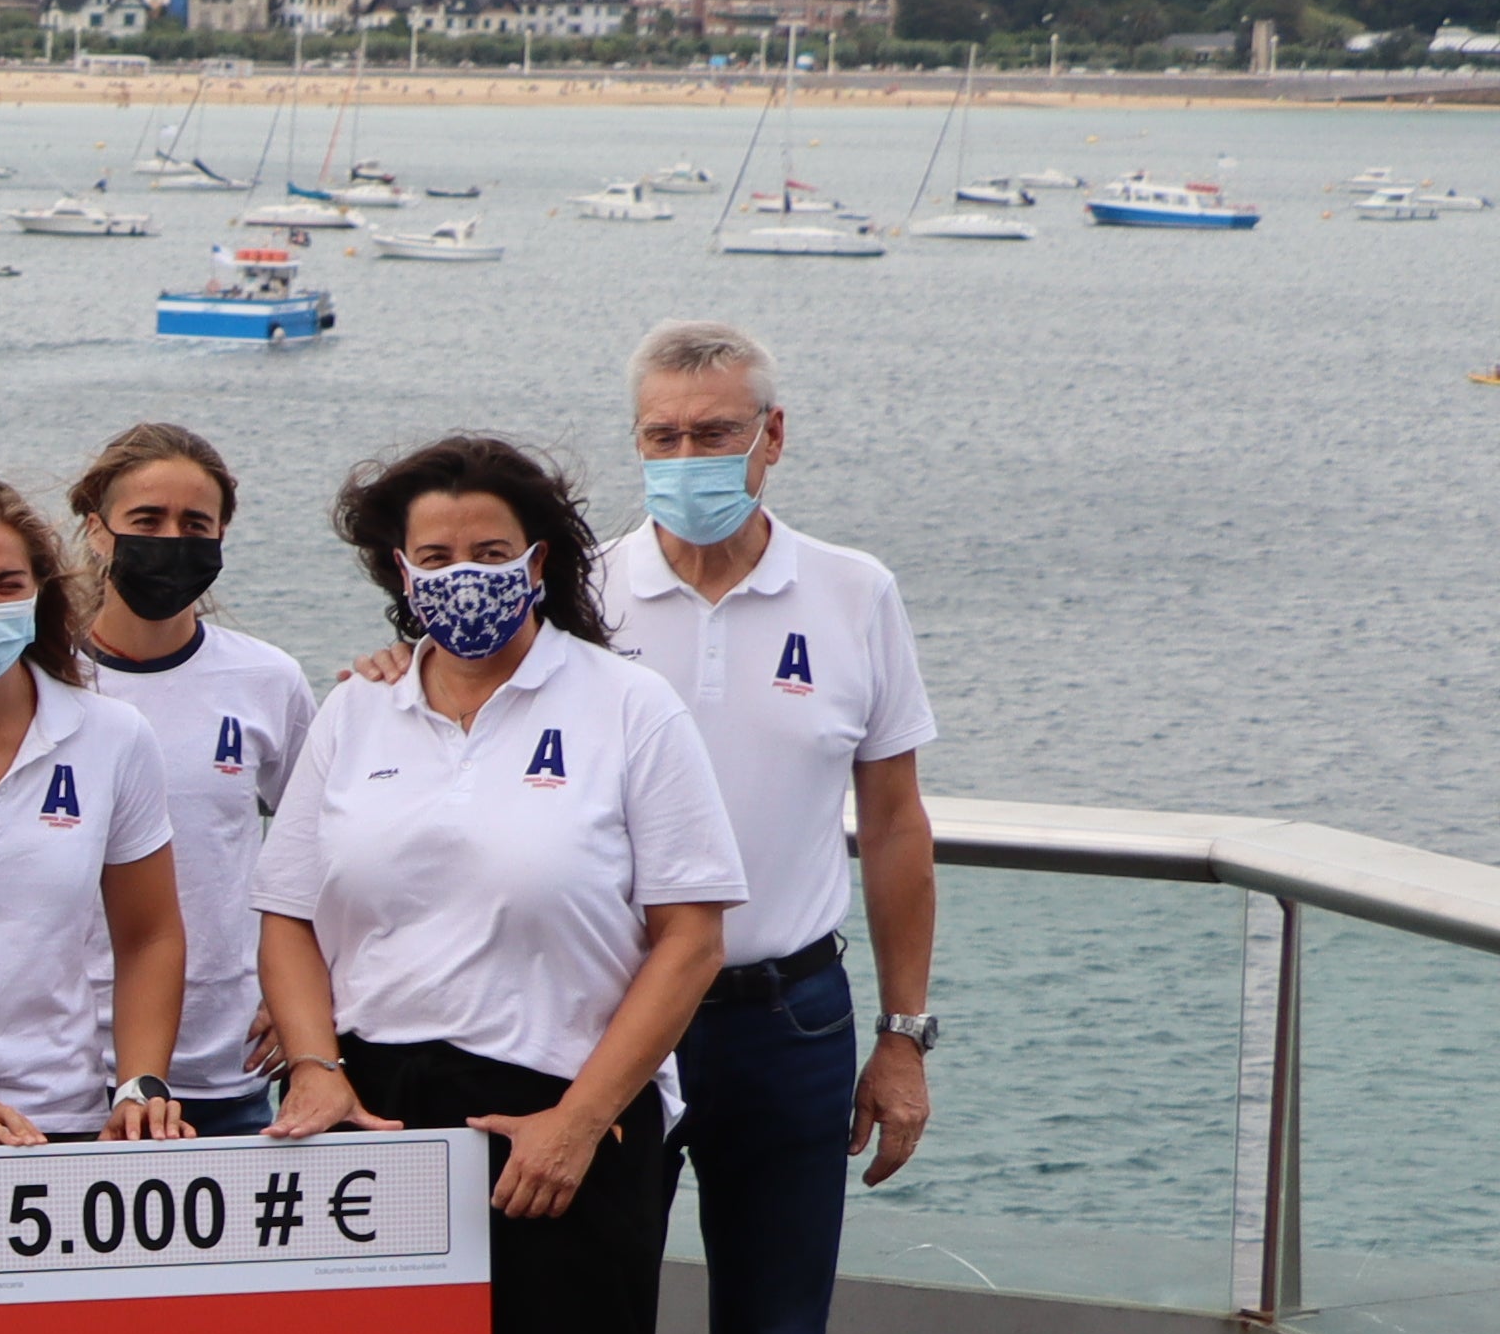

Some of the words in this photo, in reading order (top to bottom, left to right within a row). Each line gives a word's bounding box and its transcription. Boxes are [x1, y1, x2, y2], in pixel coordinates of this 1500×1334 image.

[8, 1176, 226, 1257] 5.000
[254, 1171, 304, 1247] #
[327, 1169, 377, 1243] €
